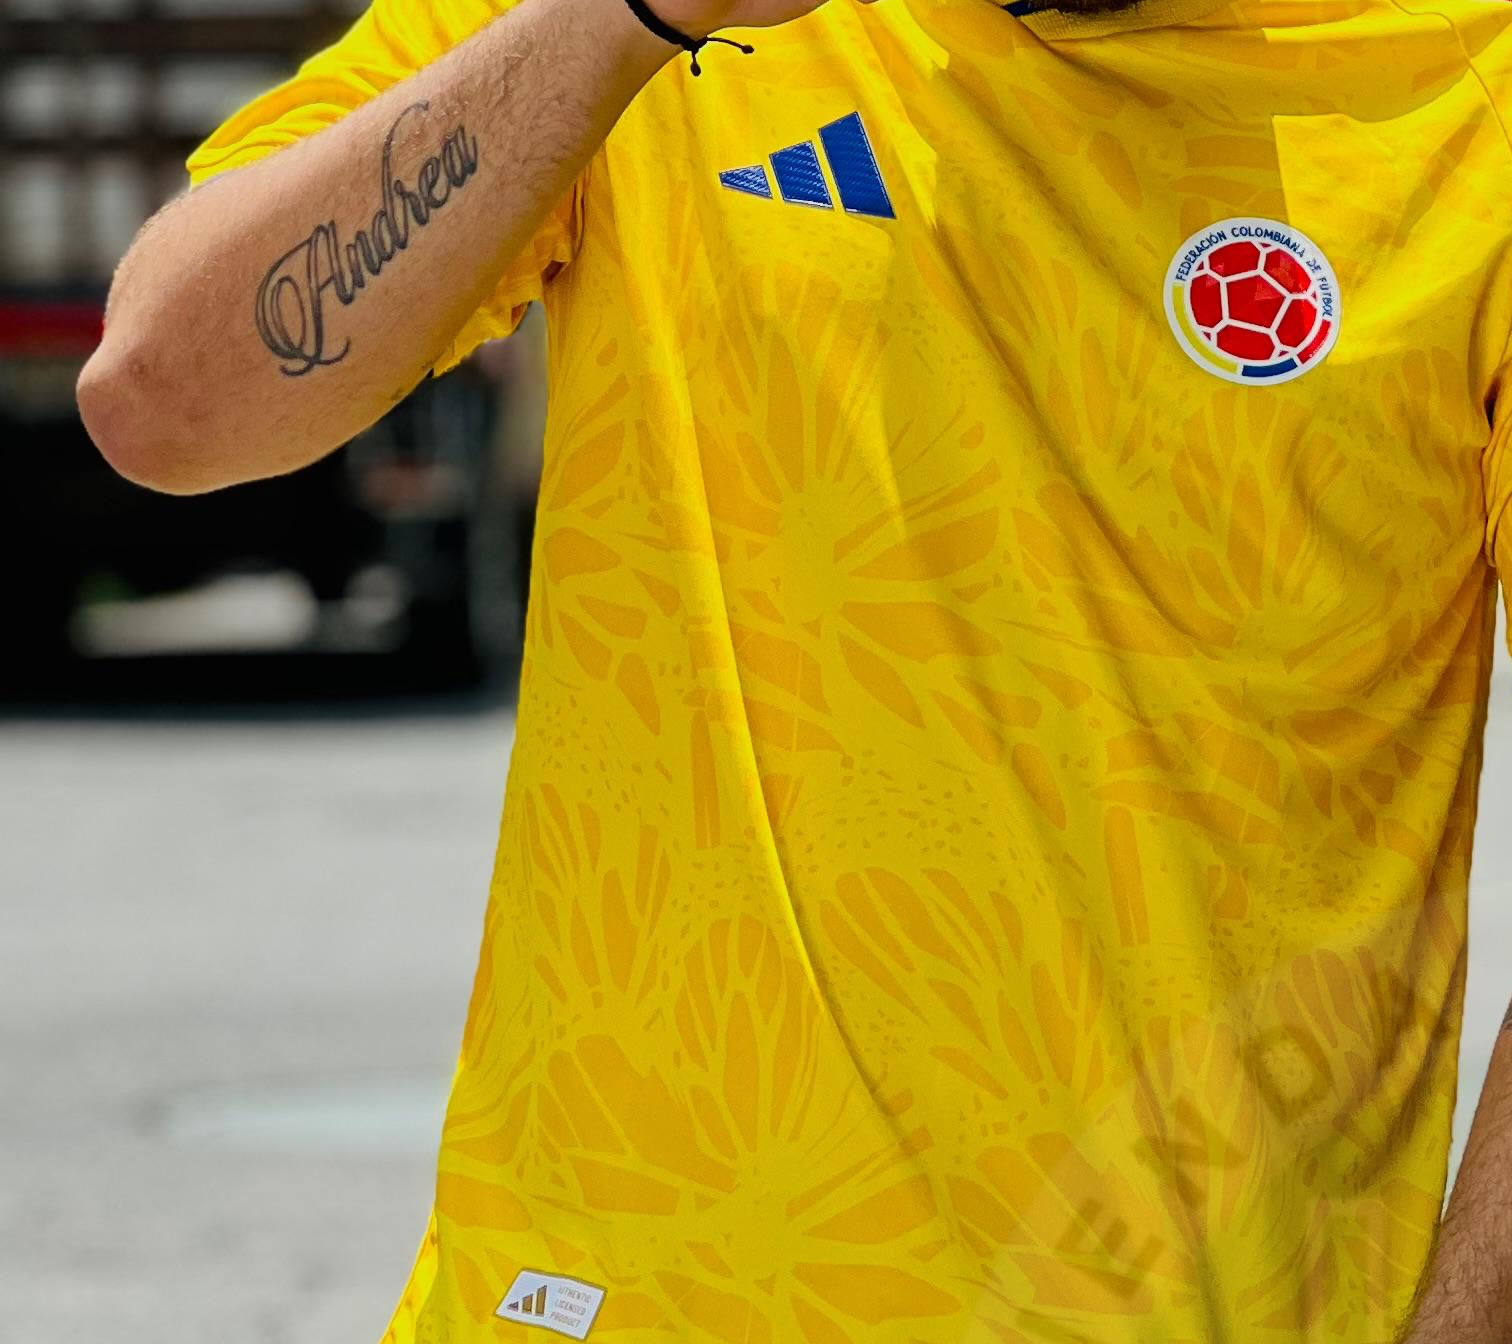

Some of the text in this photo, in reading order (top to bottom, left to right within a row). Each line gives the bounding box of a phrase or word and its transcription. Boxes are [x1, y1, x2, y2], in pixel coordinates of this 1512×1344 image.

[256, 100, 478, 377] Andrea
[1231, 226, 1305, 258] COLOMBIANA
[1306, 258, 1322, 273] DE
